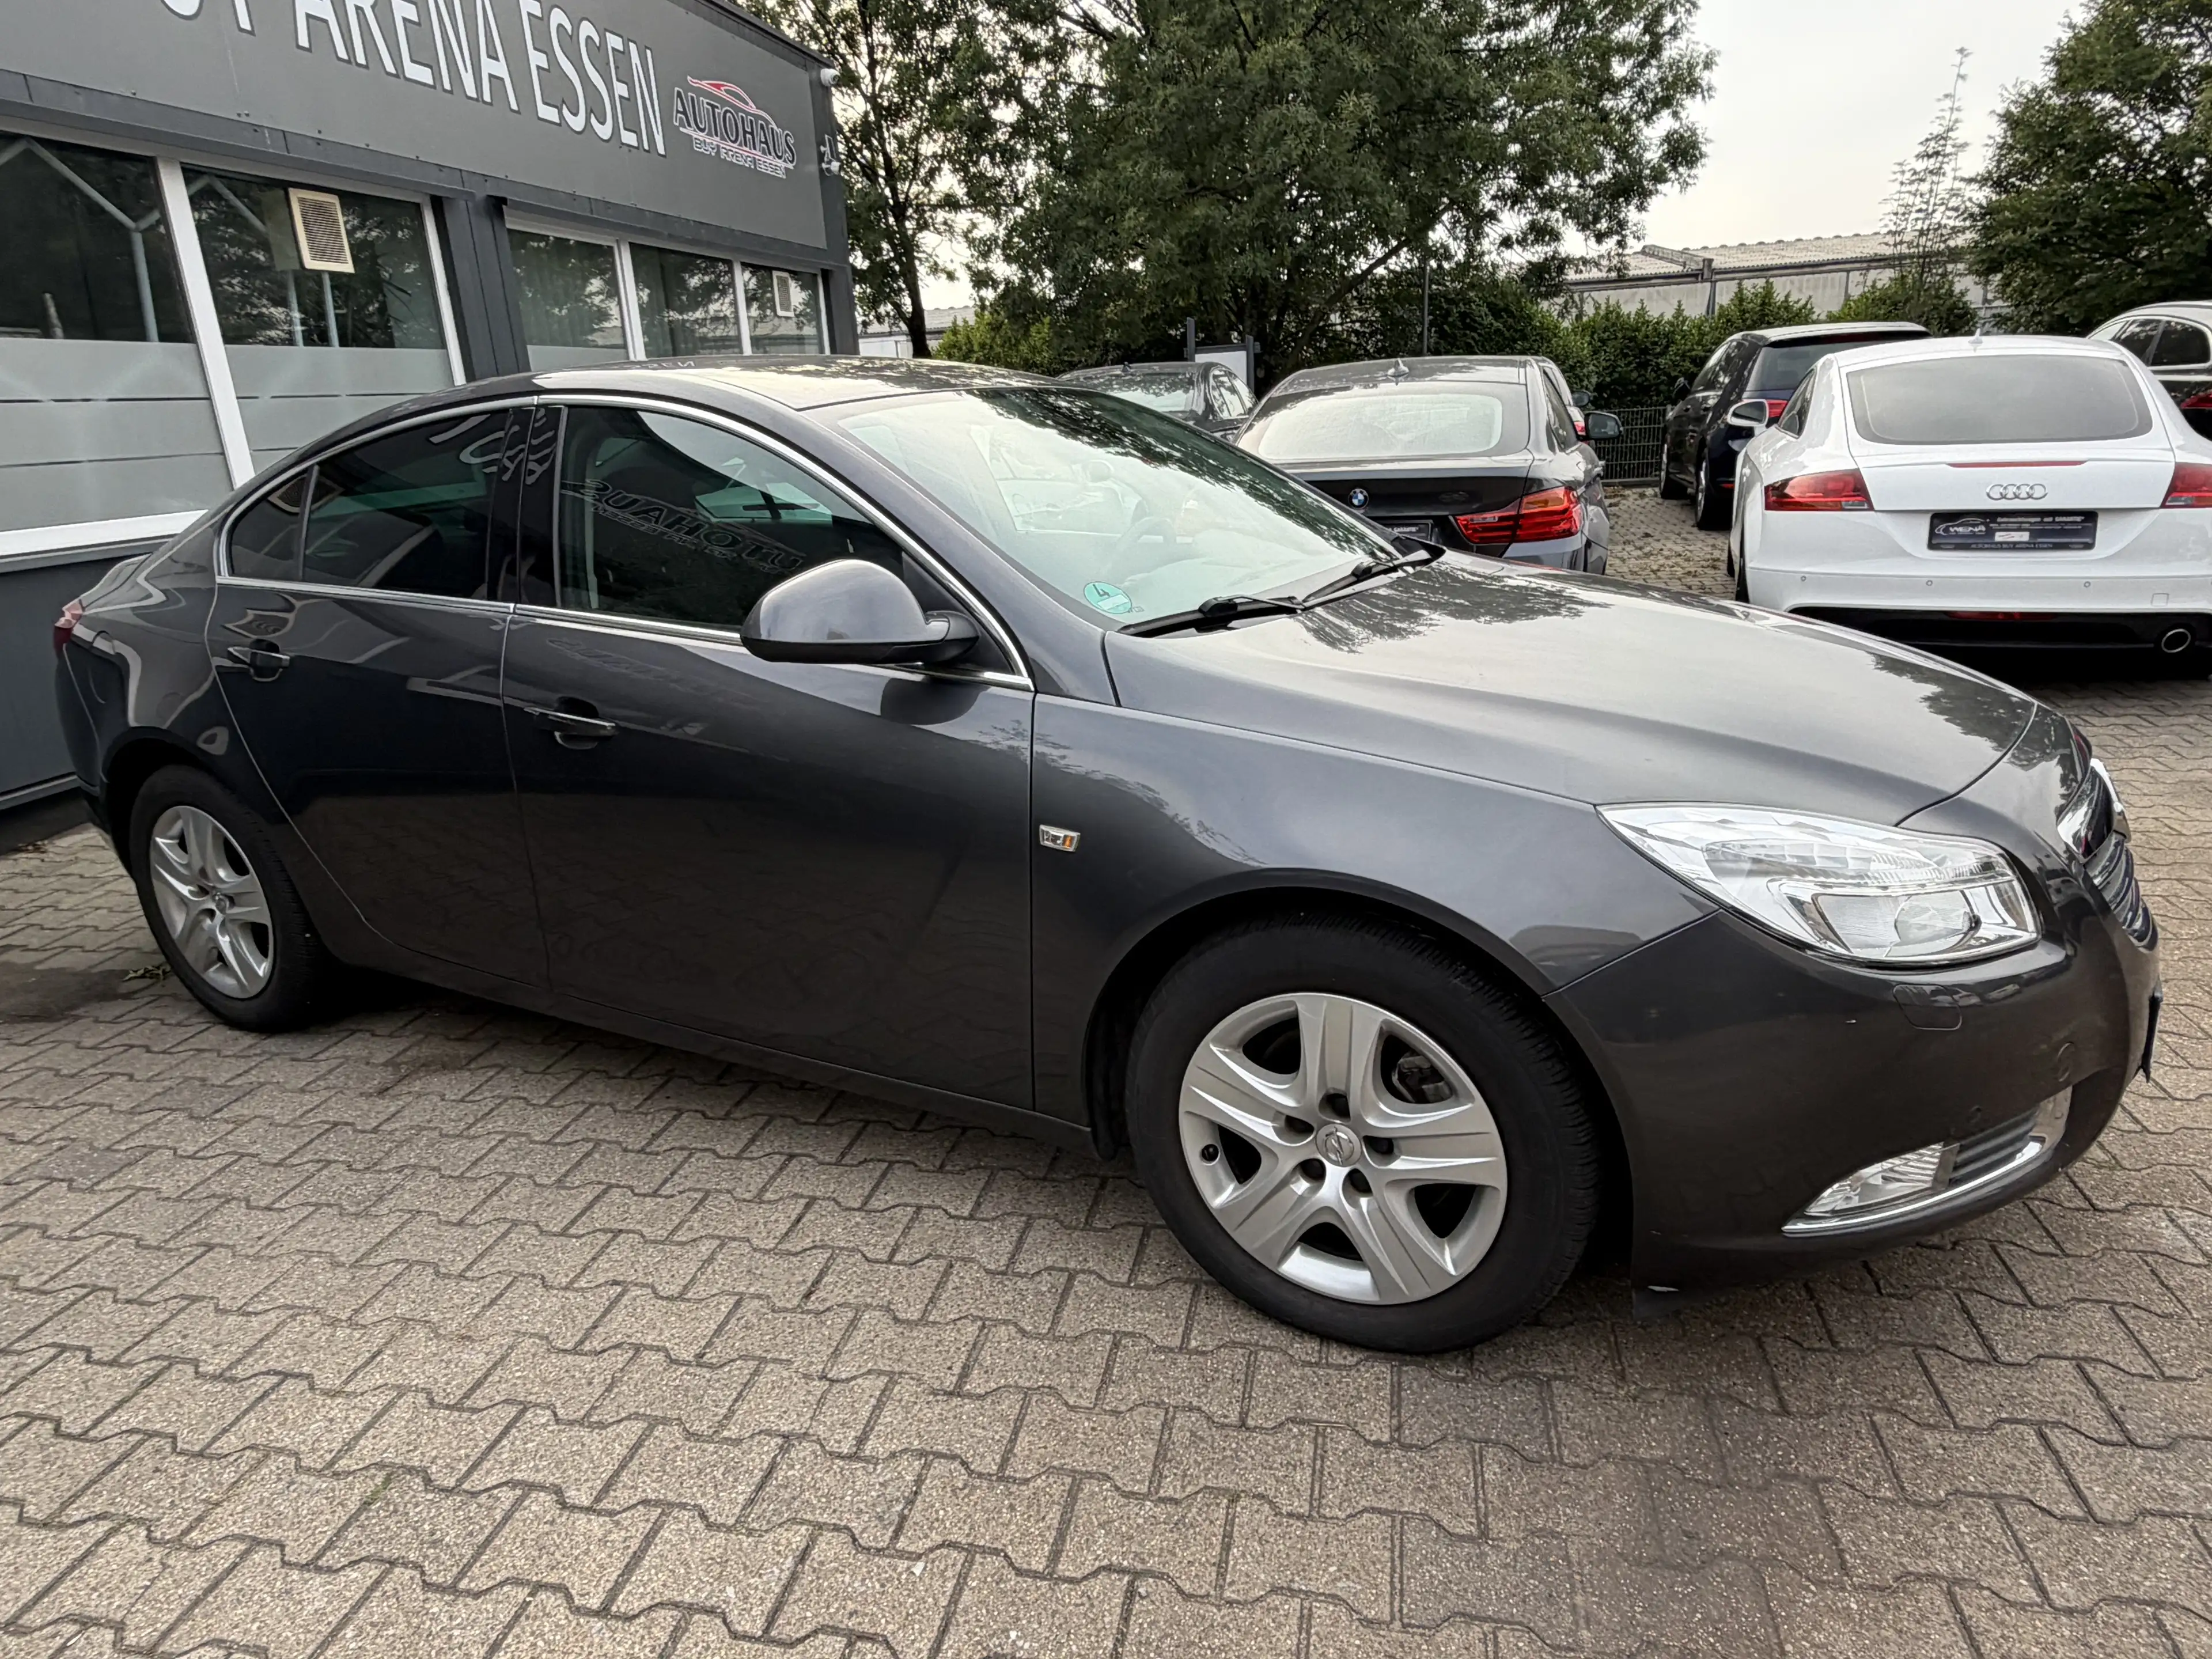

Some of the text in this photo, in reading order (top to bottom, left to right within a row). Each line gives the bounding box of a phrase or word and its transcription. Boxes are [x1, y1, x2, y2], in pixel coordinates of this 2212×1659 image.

[519, 0, 666, 157] ESSEN
[673, 87, 796, 166] AUTOHAUS
[693, 137, 717, 156] BUY
[1092, 583, 1111, 597] 4
